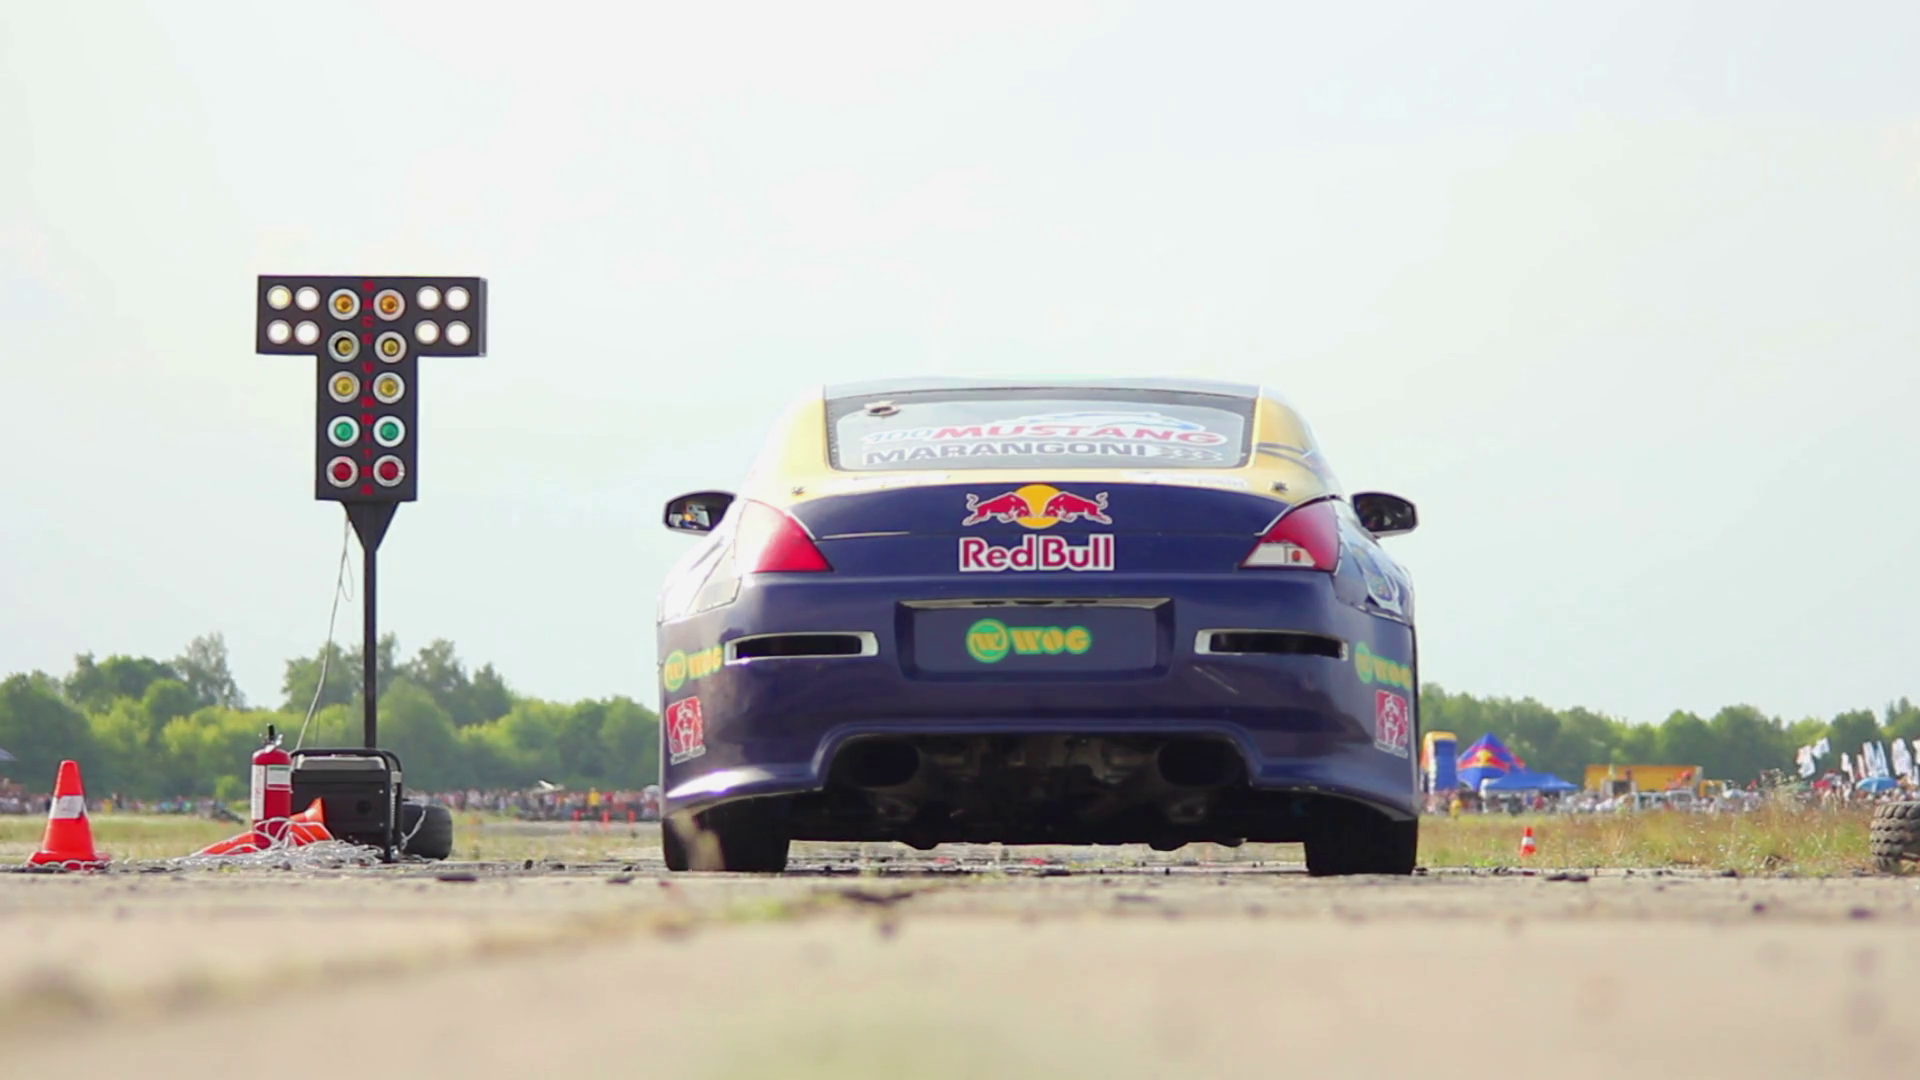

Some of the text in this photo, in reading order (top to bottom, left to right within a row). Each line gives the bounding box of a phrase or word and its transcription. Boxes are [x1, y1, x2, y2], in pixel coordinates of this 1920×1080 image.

[866, 442, 1147, 465] MARANGONI
[961, 535, 1114, 569] Red Bull
[1009, 626, 1092, 655] WOG
